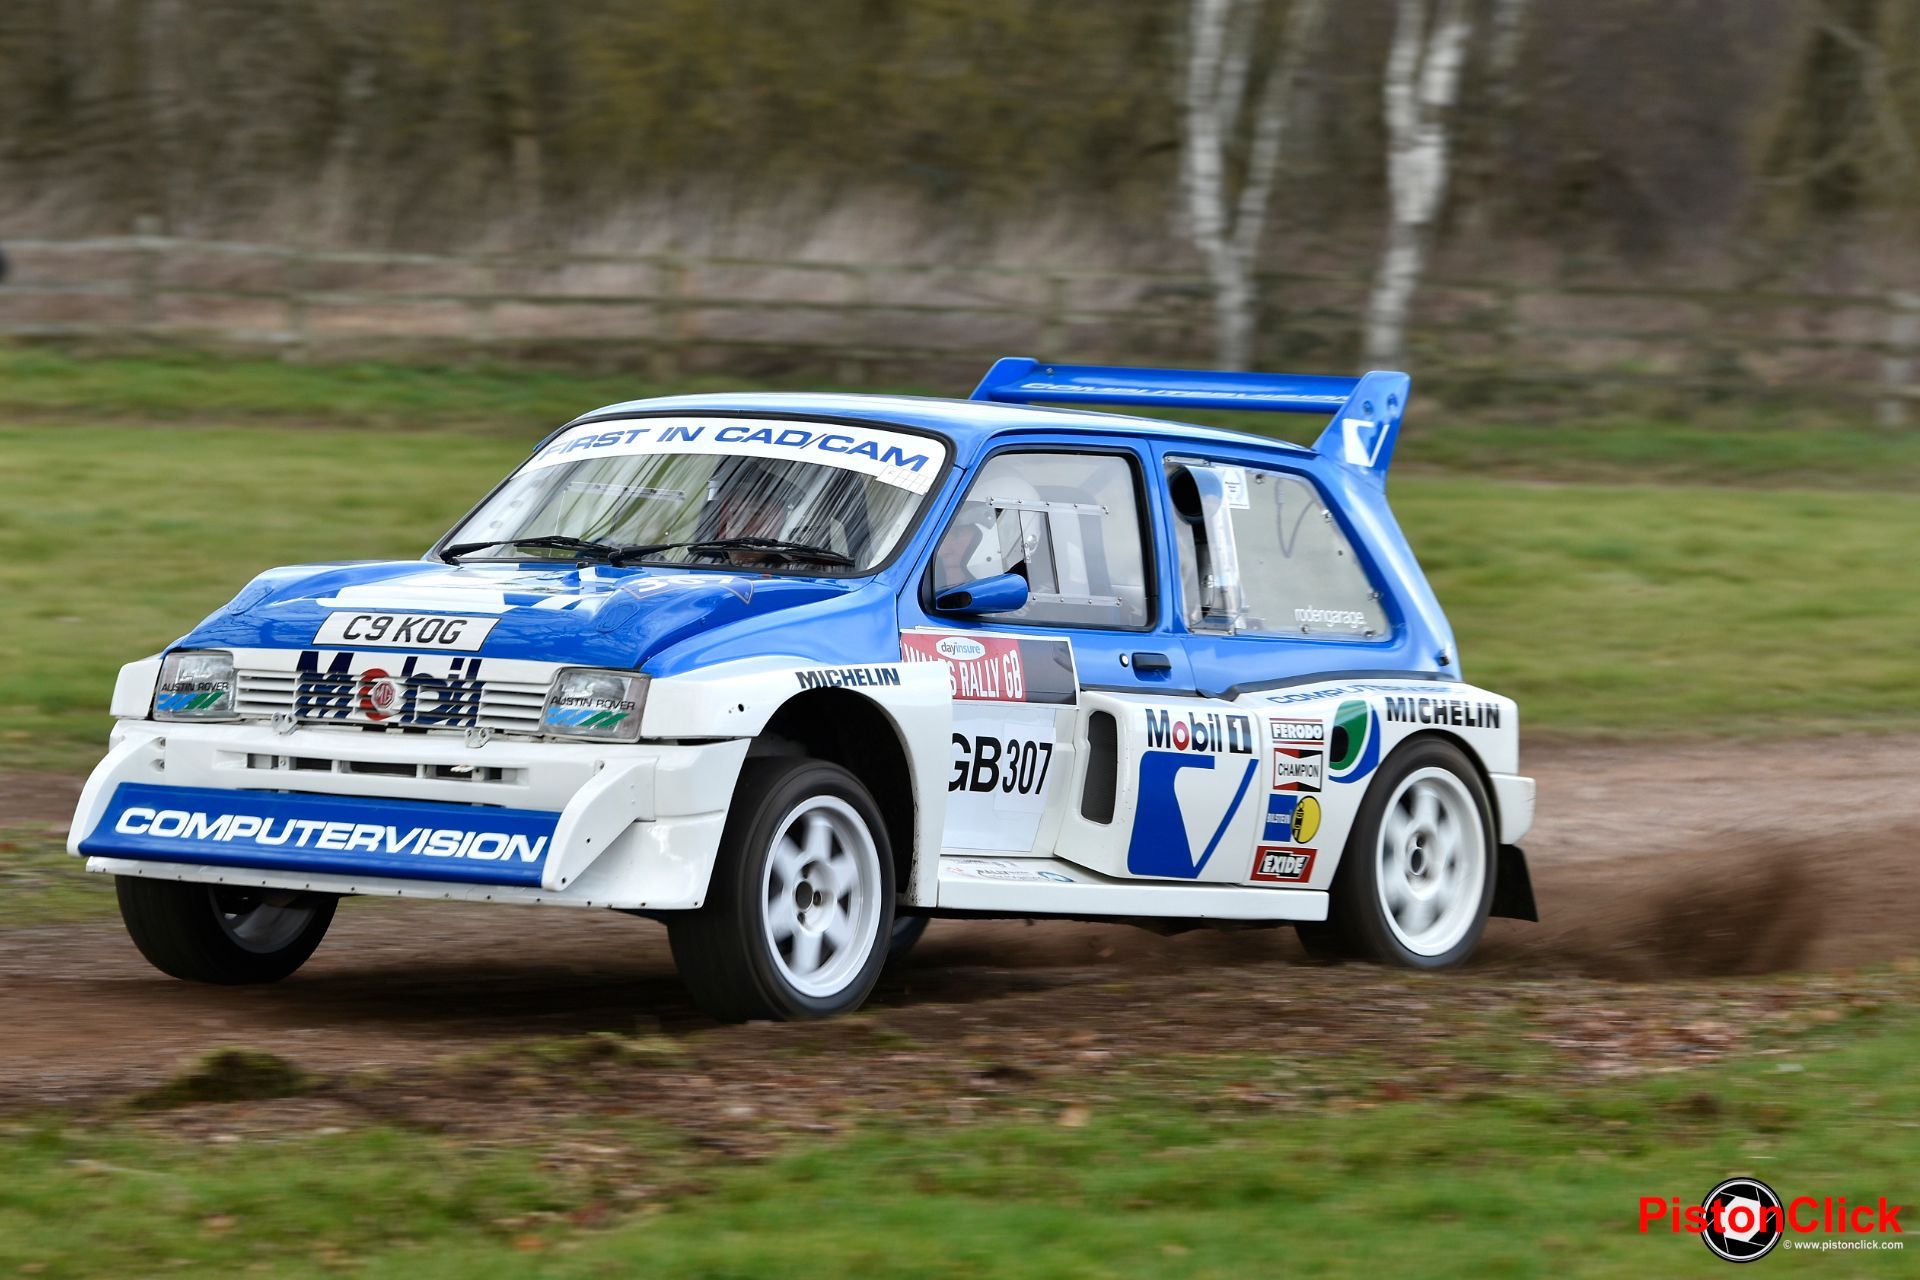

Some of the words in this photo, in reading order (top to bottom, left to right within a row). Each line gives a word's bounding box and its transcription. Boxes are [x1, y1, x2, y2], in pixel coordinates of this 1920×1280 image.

[537, 428, 651, 462] FIRST
[656, 426, 706, 443] IN
[715, 426, 930, 472] CAD/CAM
[343, 615, 395, 640] C9
[392, 617, 468, 644] KOG
[941, 642, 981, 655] dayinsure
[161, 682, 195, 692] AUSTIN
[198, 681, 229, 691] ROVER
[795, 667, 901, 689] MICHELIN
[958, 657, 1000, 698] RALLY
[1002, 649, 1024, 699] GB
[294, 651, 487, 728] Mobil
[374, 682, 394, 707] MG
[550, 696, 592, 708] AUSTIN
[596, 699, 636, 711] ROVER
[1384, 696, 1500, 729] MICHELIN
[1145, 708, 1223, 753] Mobil
[1229, 716, 1249, 753] 1
[1272, 723, 1323, 739] FERODO
[1278, 763, 1320, 777] CHAMPION
[114, 807, 549, 863] COMPUTERVISION
[1262, 855, 1306, 874] EXIDE
